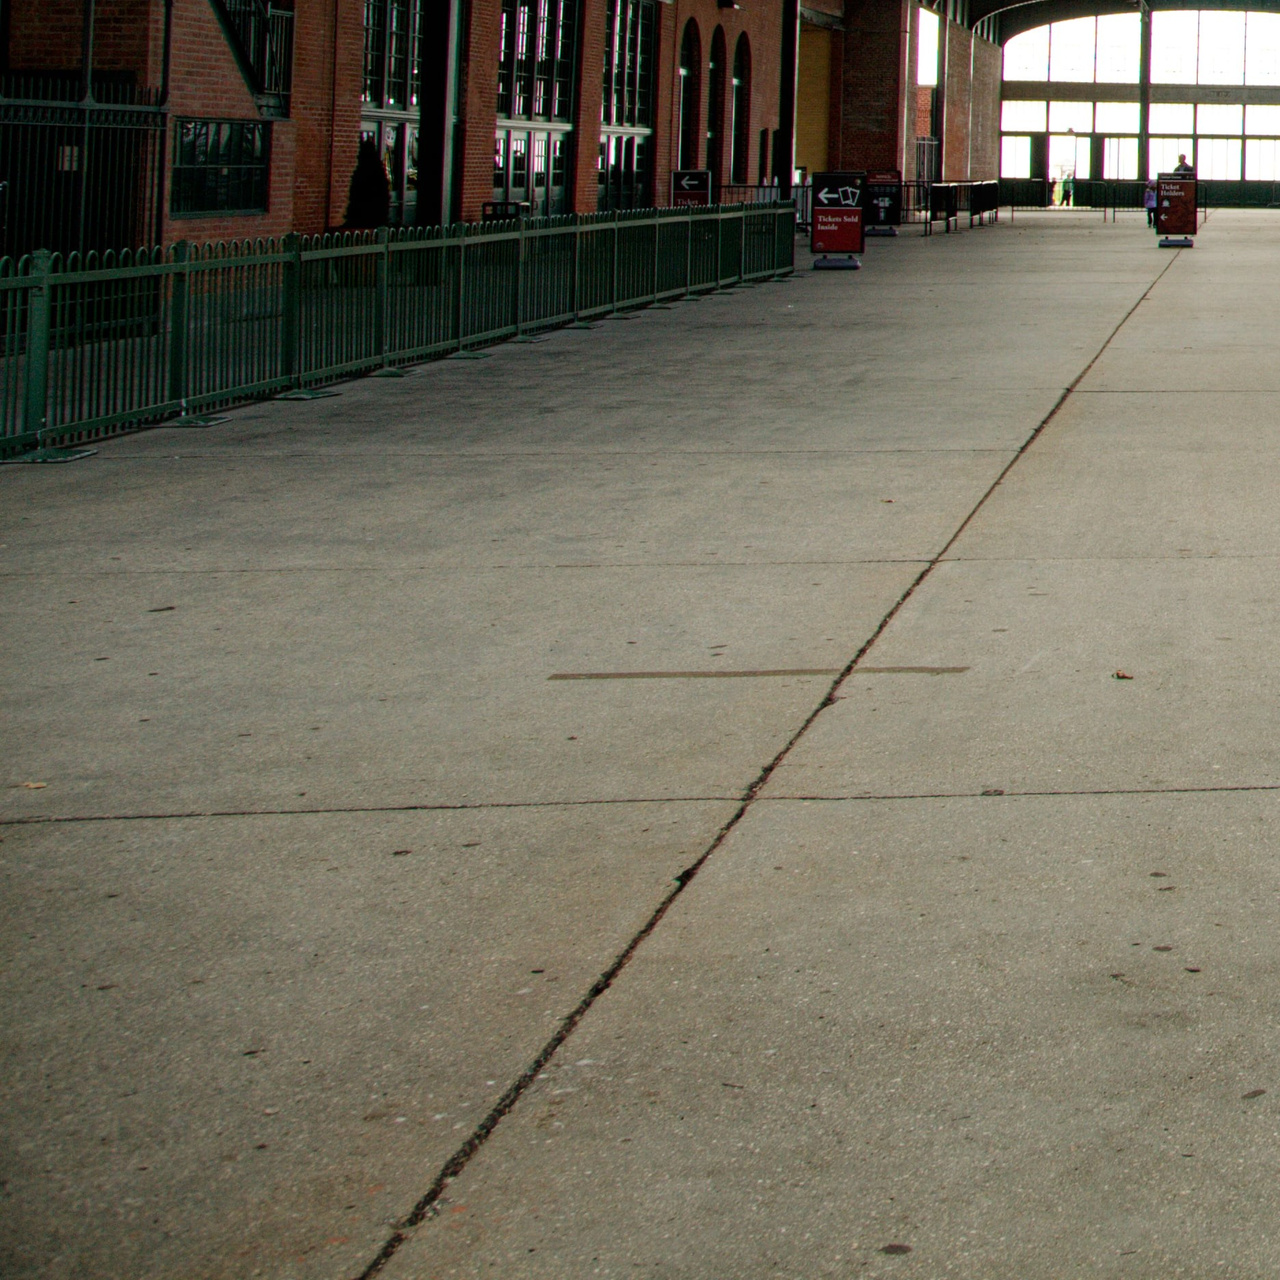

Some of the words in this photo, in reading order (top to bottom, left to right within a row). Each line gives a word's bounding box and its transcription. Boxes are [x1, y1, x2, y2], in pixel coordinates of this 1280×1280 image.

[817, 215, 842, 223] Tickets
[843, 215, 859, 223] Sold
[817, 223, 839, 231] Inside
